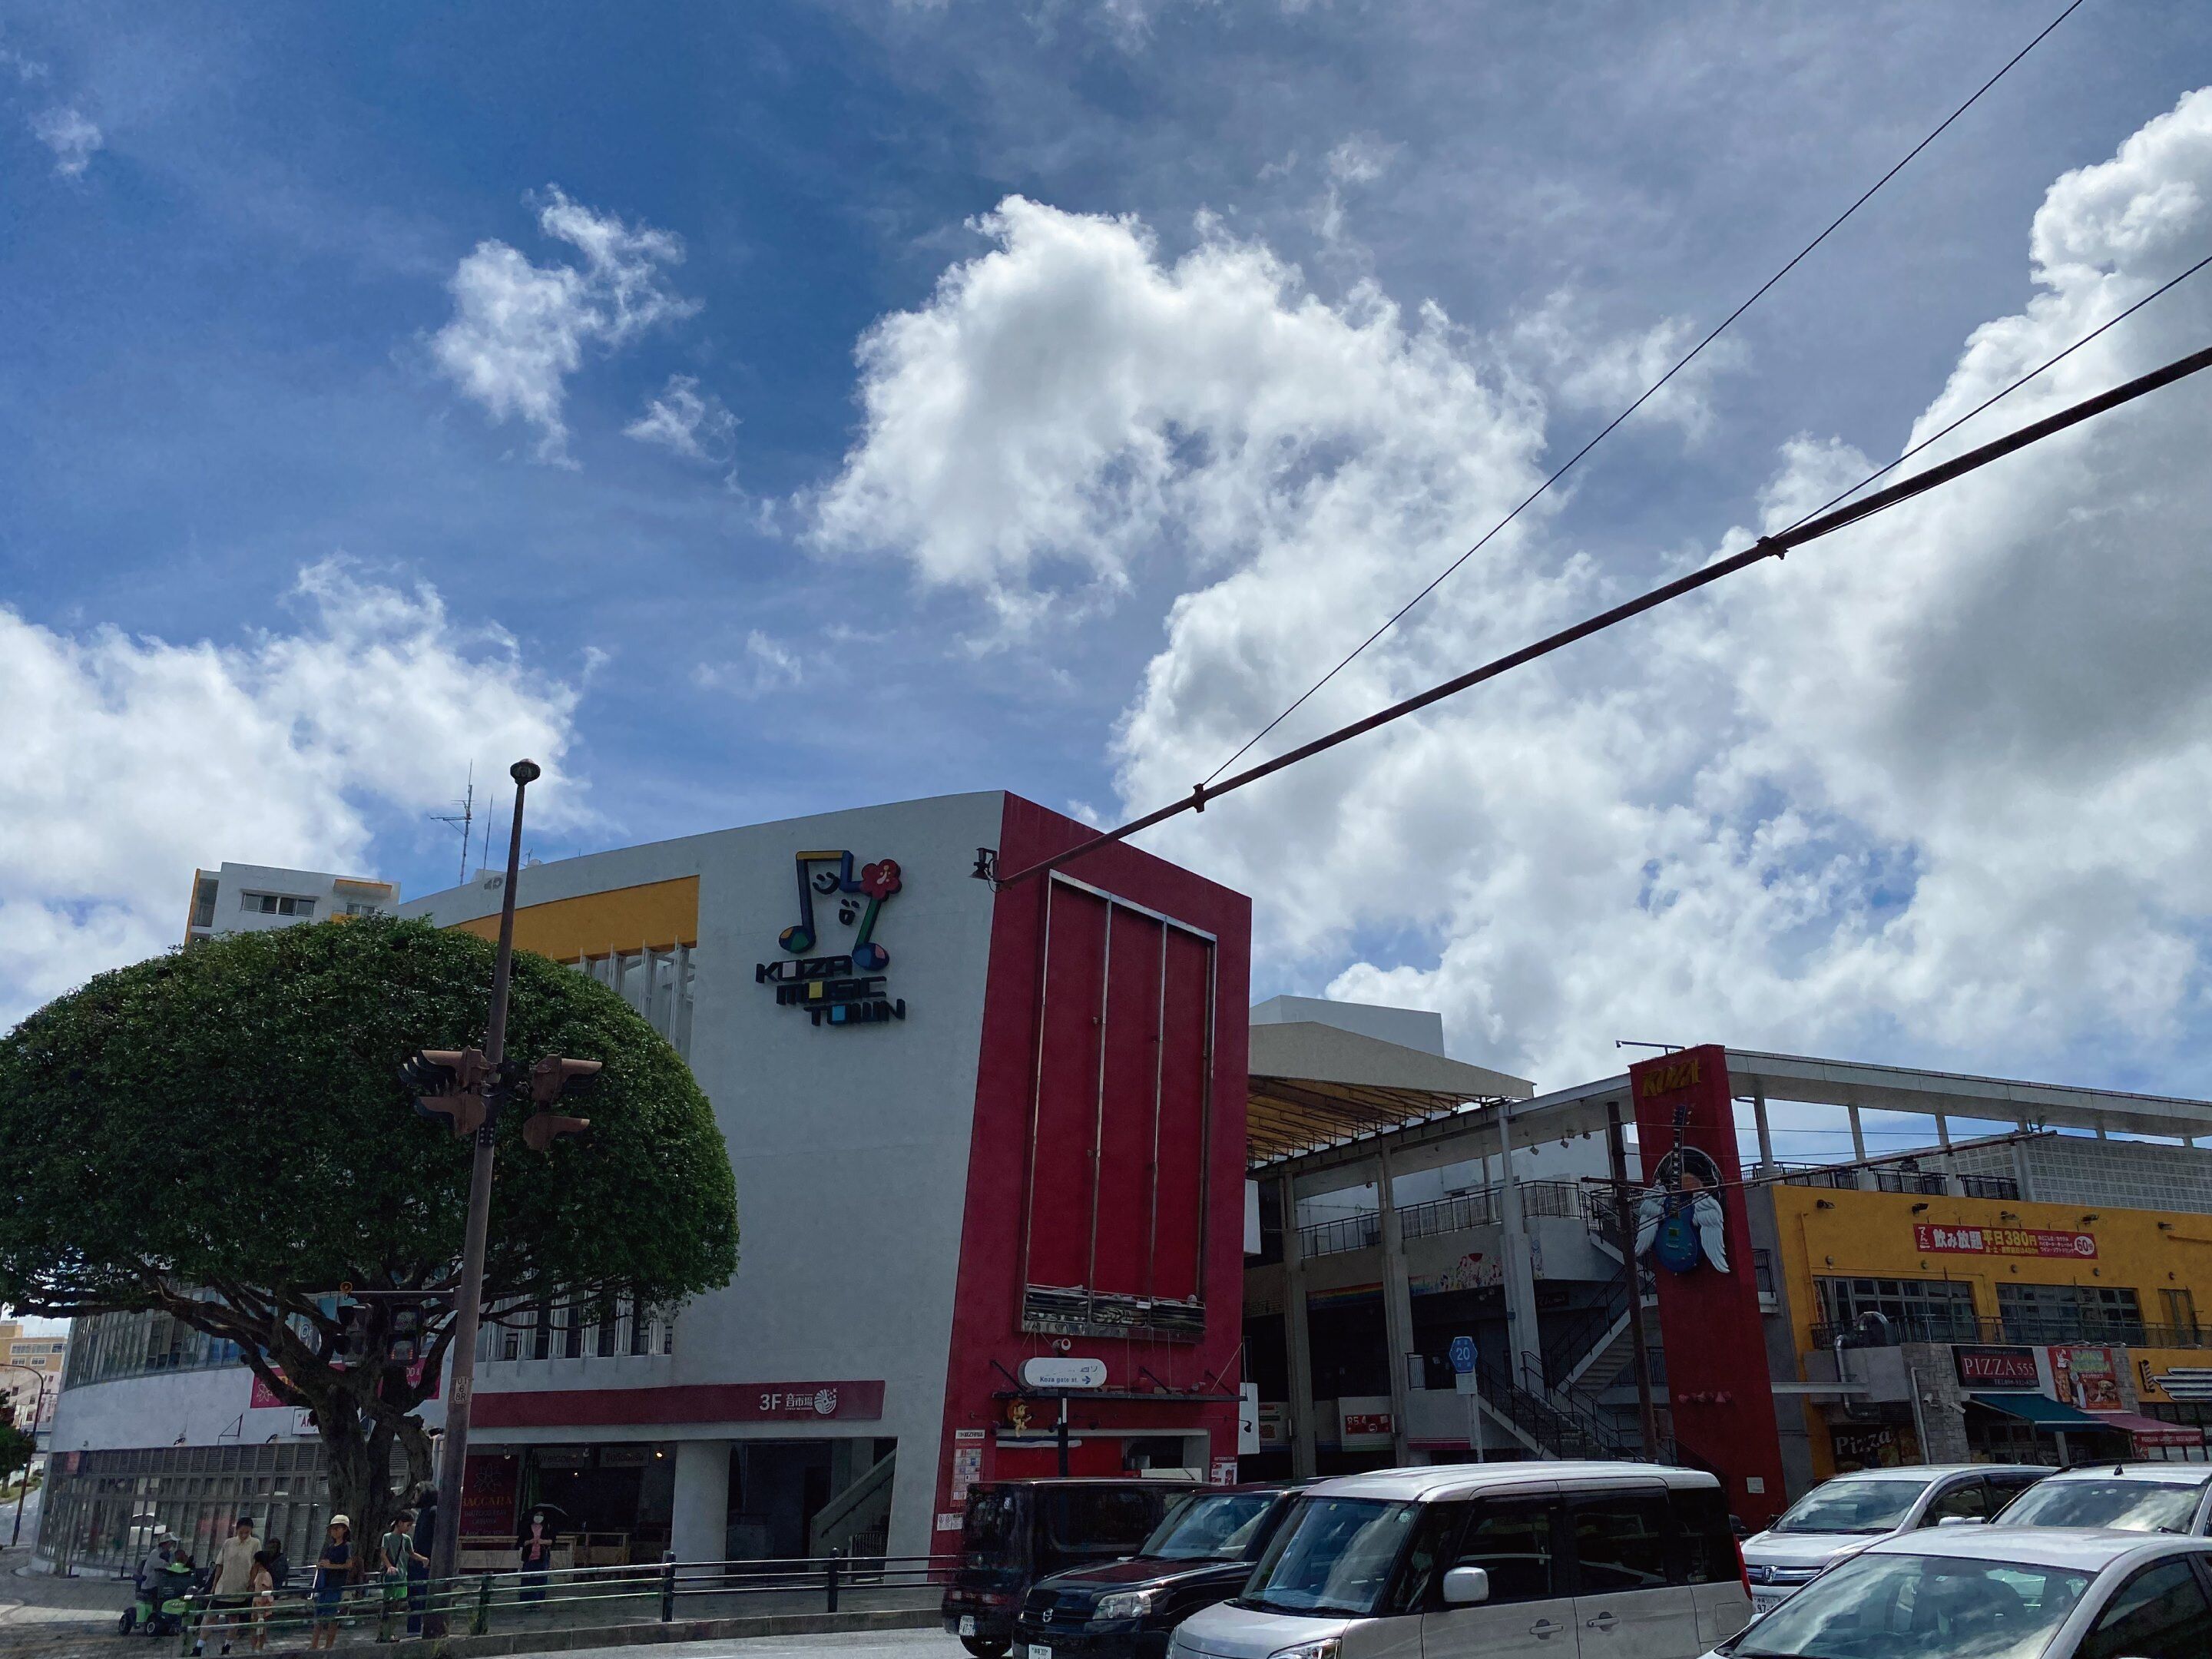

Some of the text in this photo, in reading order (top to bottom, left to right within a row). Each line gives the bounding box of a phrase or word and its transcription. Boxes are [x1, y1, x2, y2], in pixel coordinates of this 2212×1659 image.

[756, 955, 853, 983] KOZA
[803, 998, 906, 1026] TOWN
[1642, 1058, 1701, 1098] KOZA
[1932, 1228, 1983, 1250] 飲み放題
[1456, 1346, 1470, 1360] 20
[1963, 1357, 2035, 1376] PIZZA 555
[455, 1392, 466, 1401] 8R
[759, 1393, 782, 1411] 3F
[1836, 1429, 1893, 1455] Pizza
